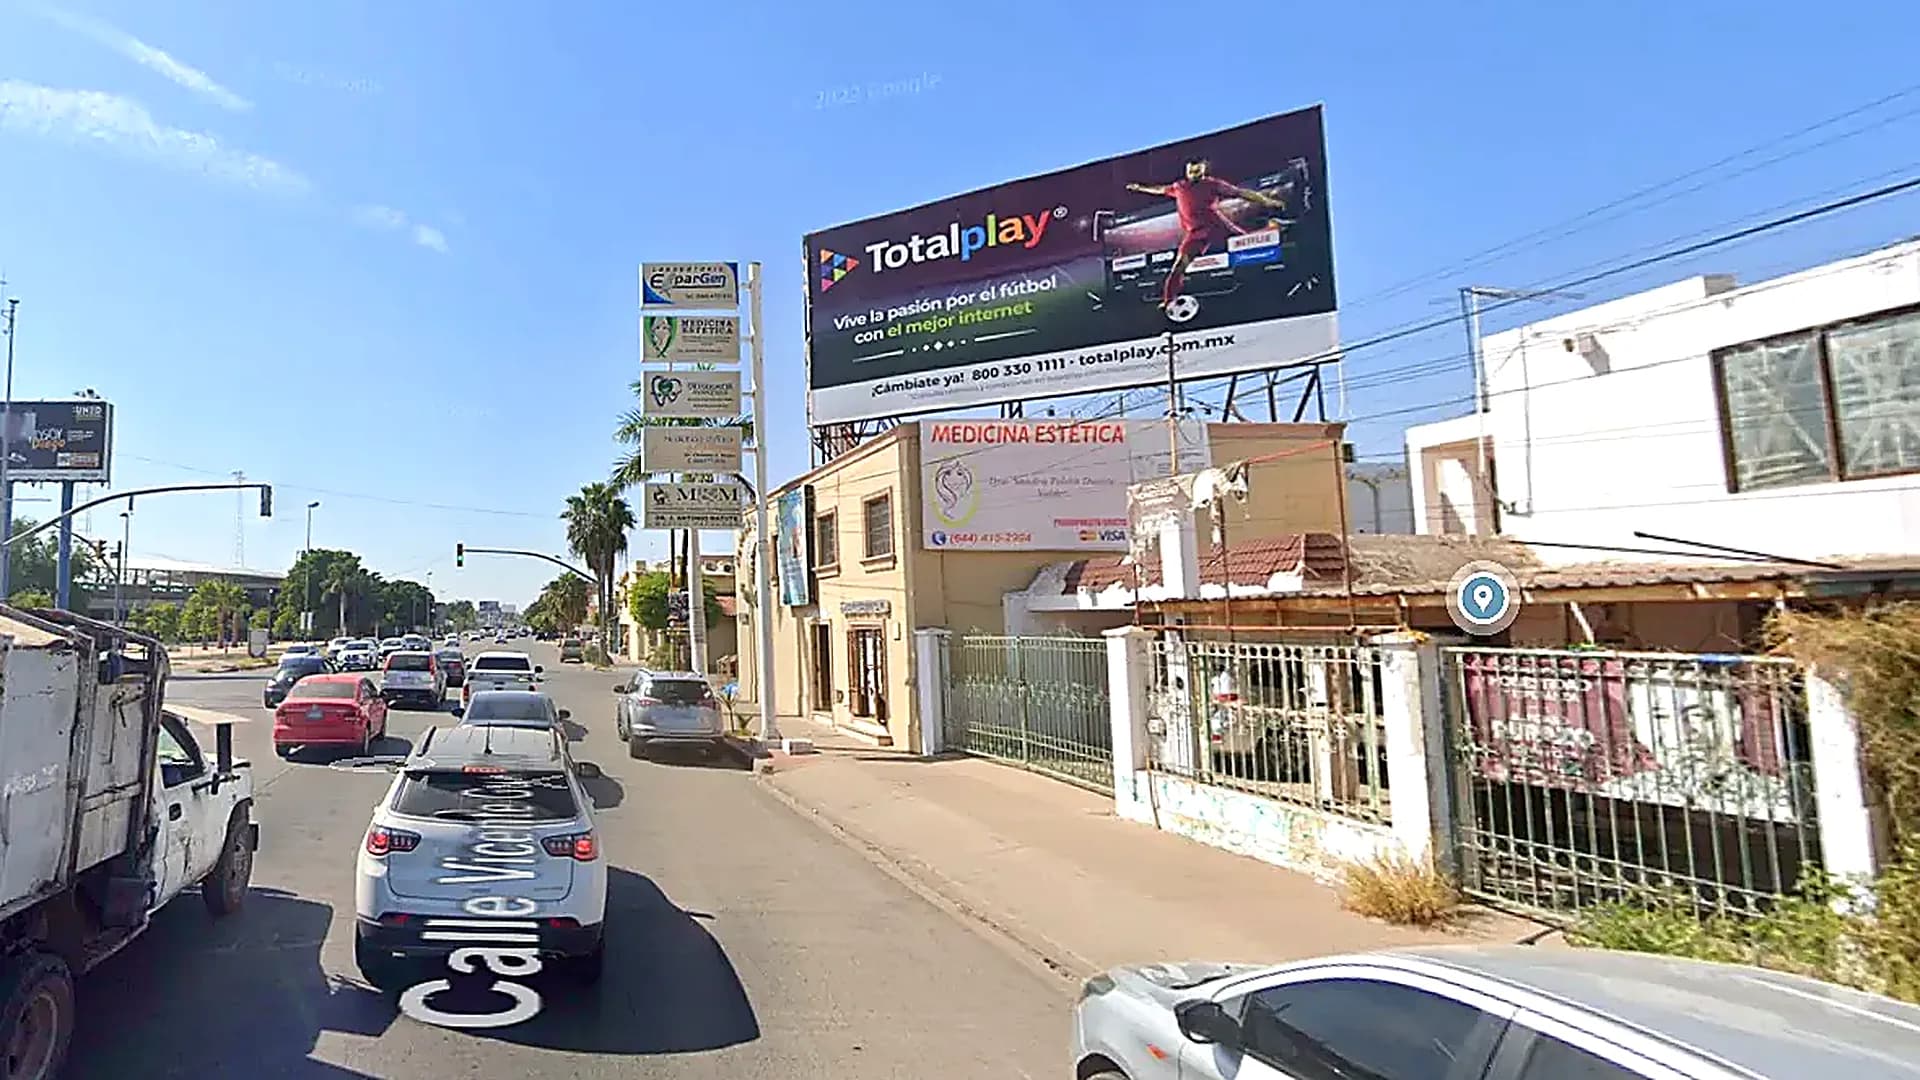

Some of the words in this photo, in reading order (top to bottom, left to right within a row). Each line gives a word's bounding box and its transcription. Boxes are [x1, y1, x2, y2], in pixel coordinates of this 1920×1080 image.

[865, 210, 1050, 273] Totalplay
[834, 315, 867, 331] Vive
[870, 306, 884, 322] la
[888, 295, 942, 321] pasión
[946, 292, 976, 316] por
[980, 284, 996, 302] el
[1000, 275, 1057, 298] fútbol
[854, 331, 884, 345] con
[887, 324, 902, 338] el
[906, 316, 955, 337] mejor
[959, 302, 1033, 325] internet
[943, 372, 964, 389] ya!
[972, 366, 999, 381] 800
[1003, 362, 1031, 377] 330
[1037, 358, 1065, 373] 1111
[1079, 334, 1235, 366] totalplay.com.mx
[931, 425, 1029, 444] MEDICINA
[1099, 530, 1126, 541] VISA
